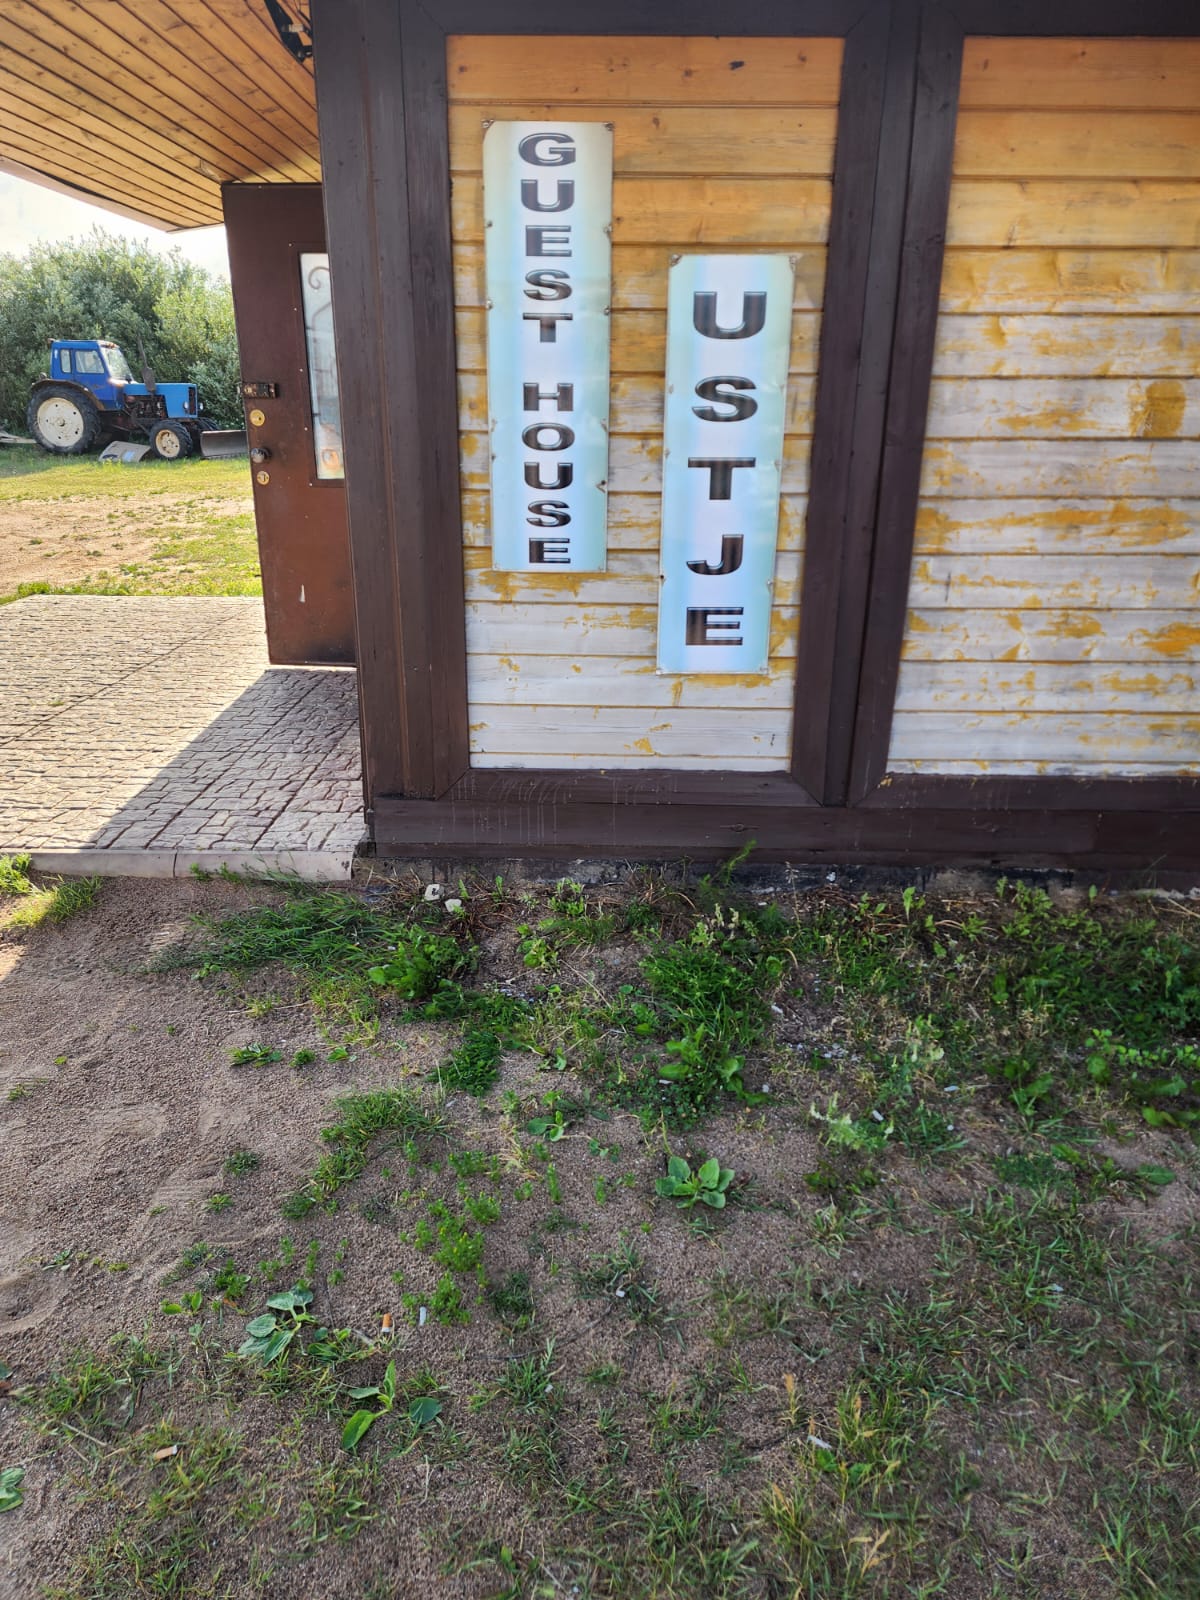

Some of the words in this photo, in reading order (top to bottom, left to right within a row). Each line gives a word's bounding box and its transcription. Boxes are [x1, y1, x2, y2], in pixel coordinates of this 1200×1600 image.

[518, 132, 576, 343] GUEST
[521, 382, 575, 564] HOUSE
[685, 290, 766, 646] USTJE
